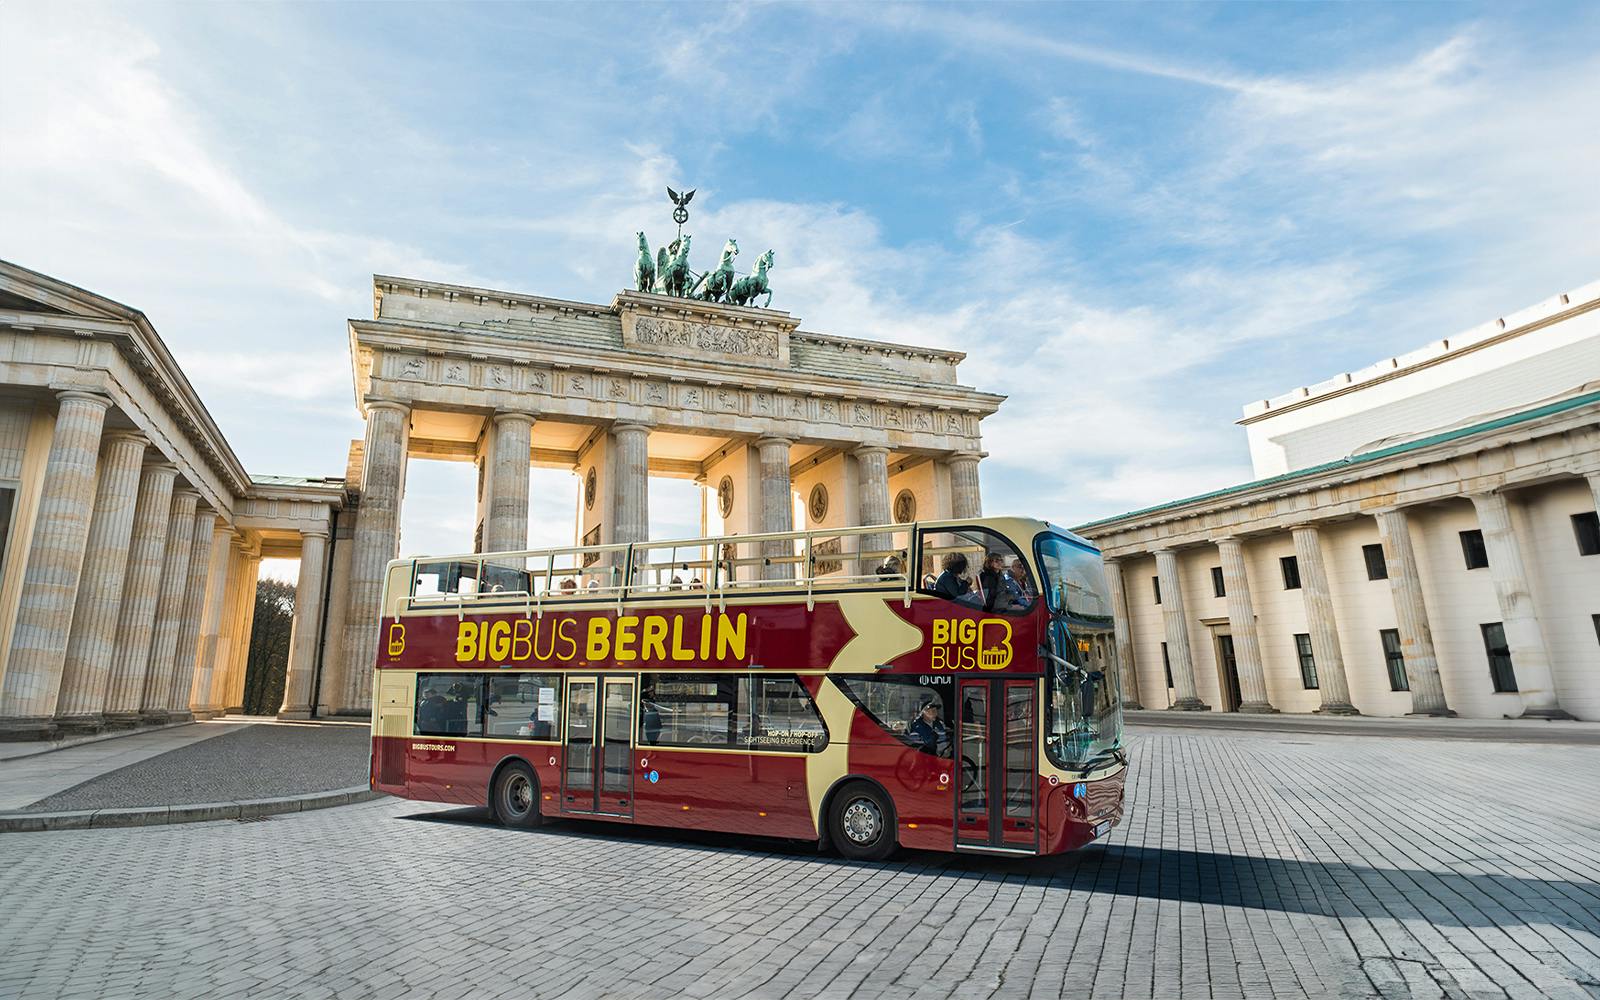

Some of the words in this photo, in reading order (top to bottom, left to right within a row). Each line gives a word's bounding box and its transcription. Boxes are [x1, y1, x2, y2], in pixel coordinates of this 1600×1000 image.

[585, 612, 747, 661] BERLIN
[932, 618, 977, 645] BIG
[931, 645, 976, 670] BUS
[412, 743, 456, 752] BIGBUSTOURS.COM
[744, 736, 779, 745] SIGHTSEEING
[780, 737, 816, 746] EXPERIENCE
